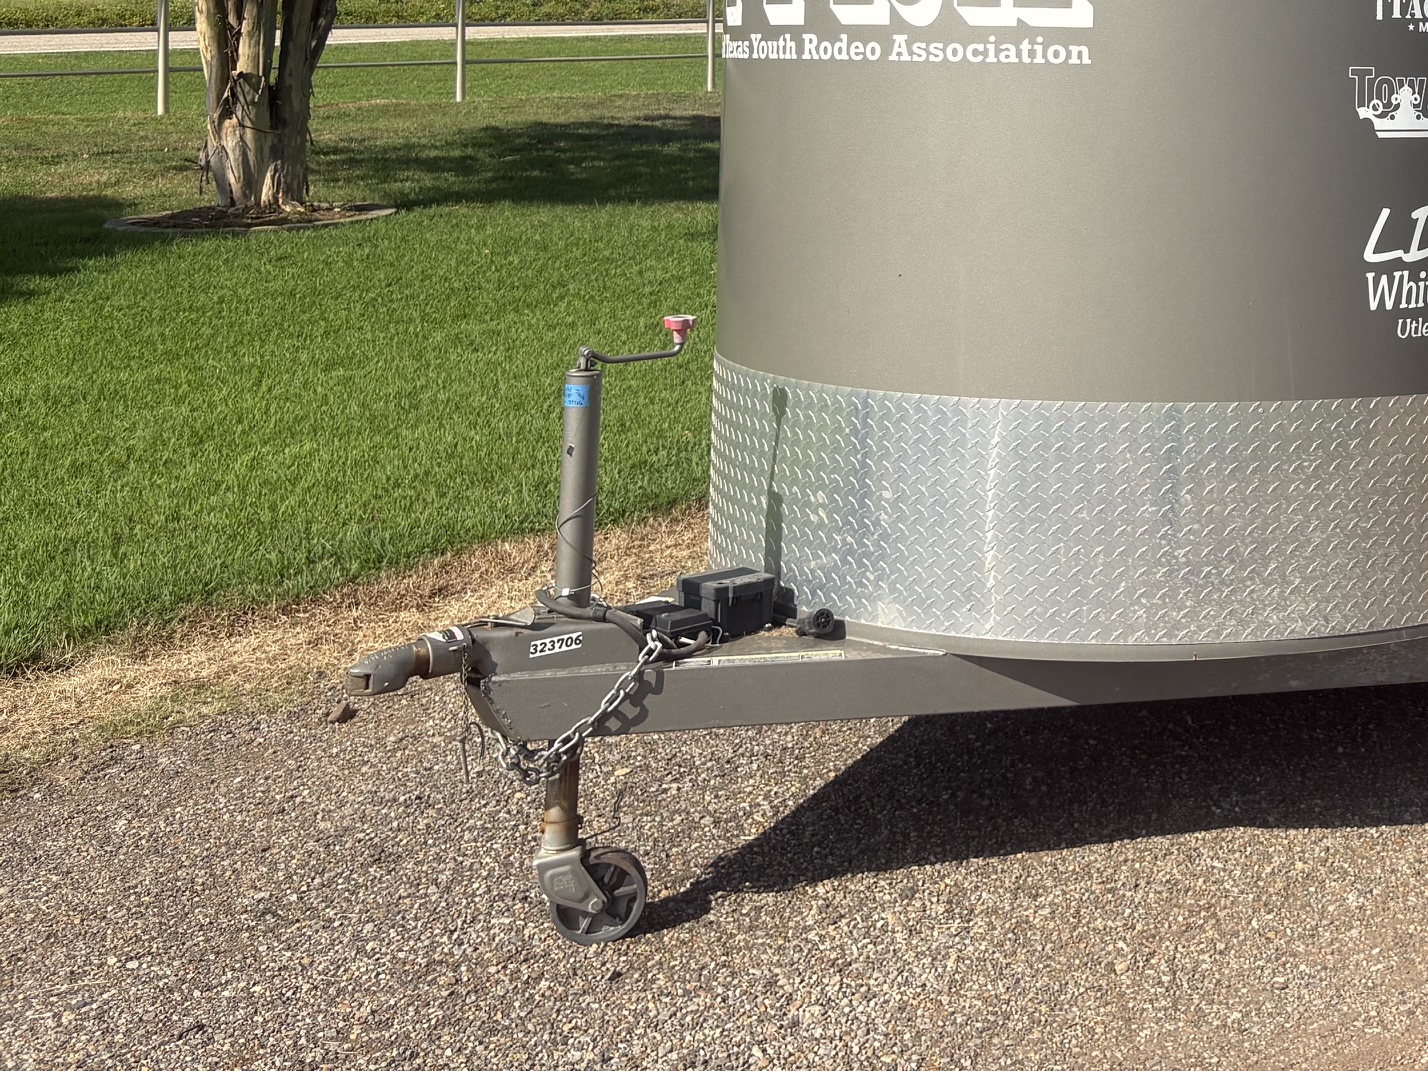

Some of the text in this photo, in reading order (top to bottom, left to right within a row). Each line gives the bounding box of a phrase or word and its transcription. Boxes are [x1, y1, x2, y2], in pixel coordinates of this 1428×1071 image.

[750, 33, 798, 60] Youth
[801, 33, 881, 62] Rodeo
[888, 34, 1092, 65] Association
[1349, 67, 1427, 111] Tow
[530, 634, 582, 655] 323706
